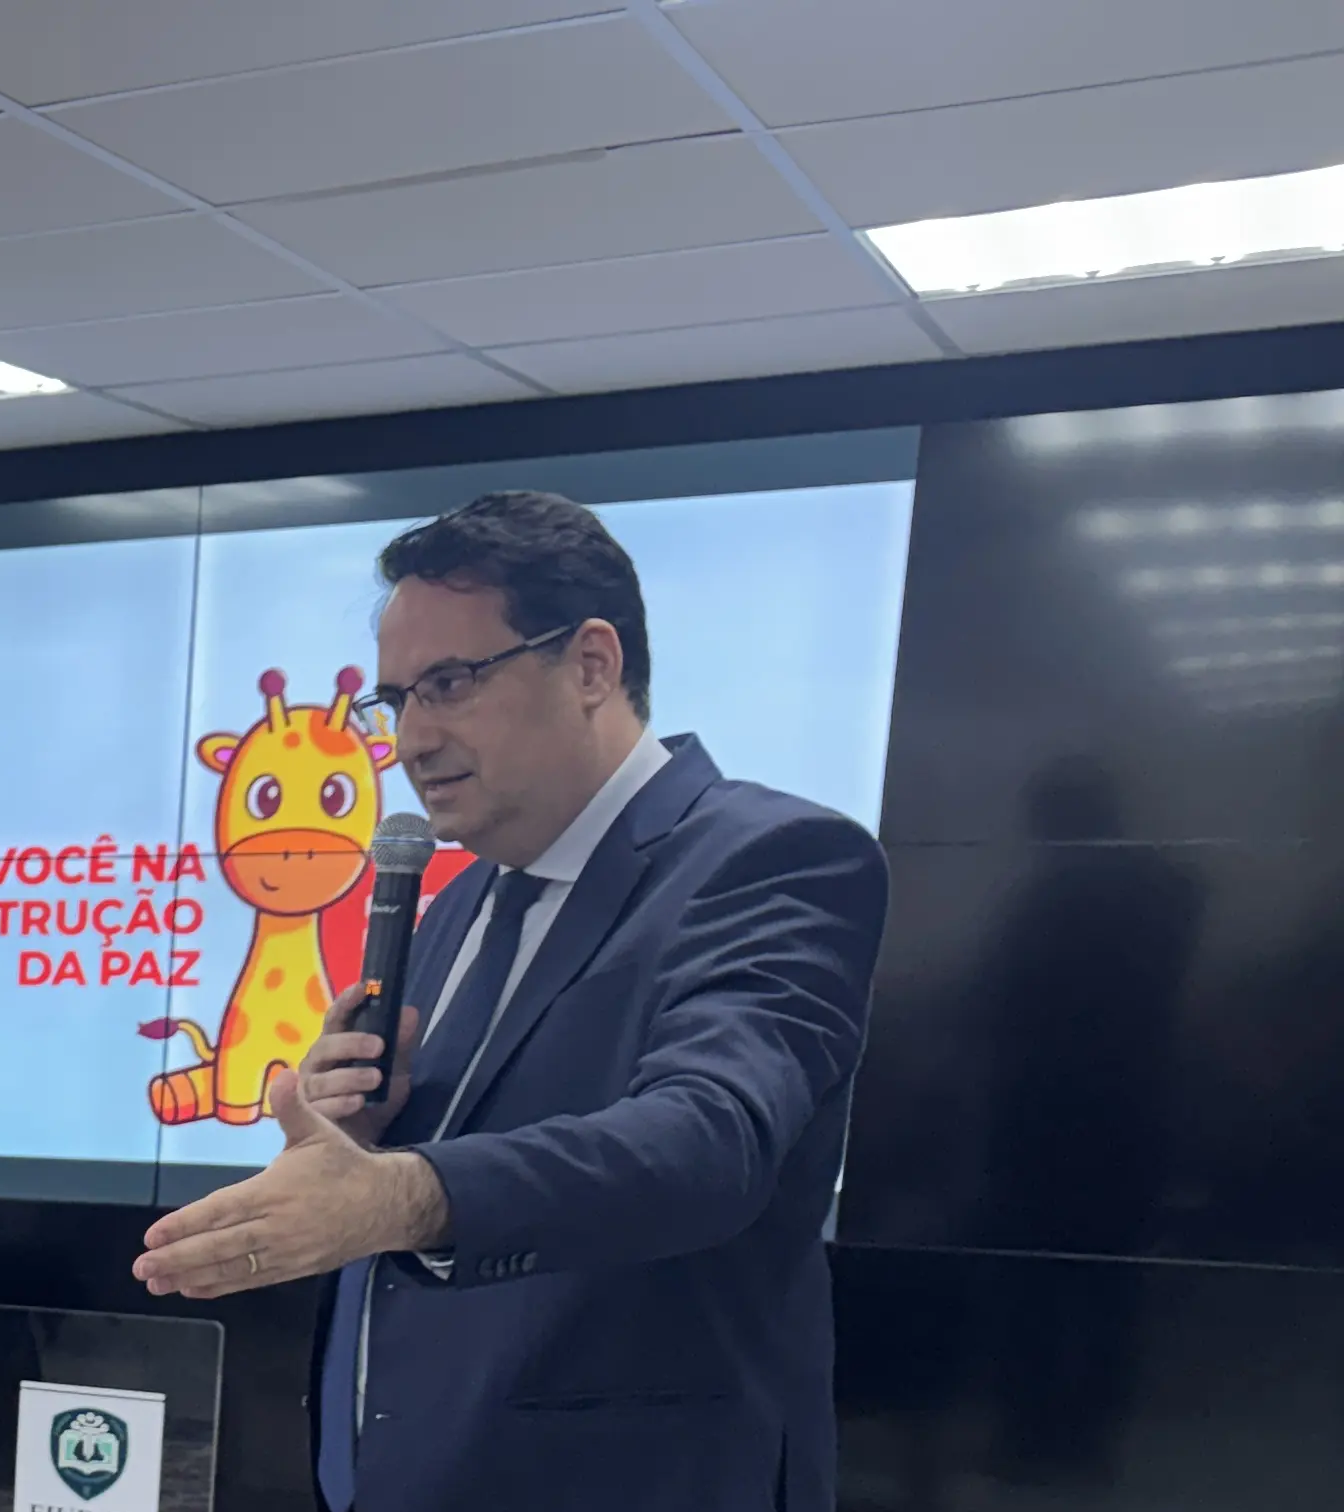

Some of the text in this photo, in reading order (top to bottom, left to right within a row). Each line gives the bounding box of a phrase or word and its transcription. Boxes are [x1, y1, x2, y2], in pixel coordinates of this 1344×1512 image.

[132, 842, 207, 884] NA
[18, 949, 202, 987] DA PAZ
